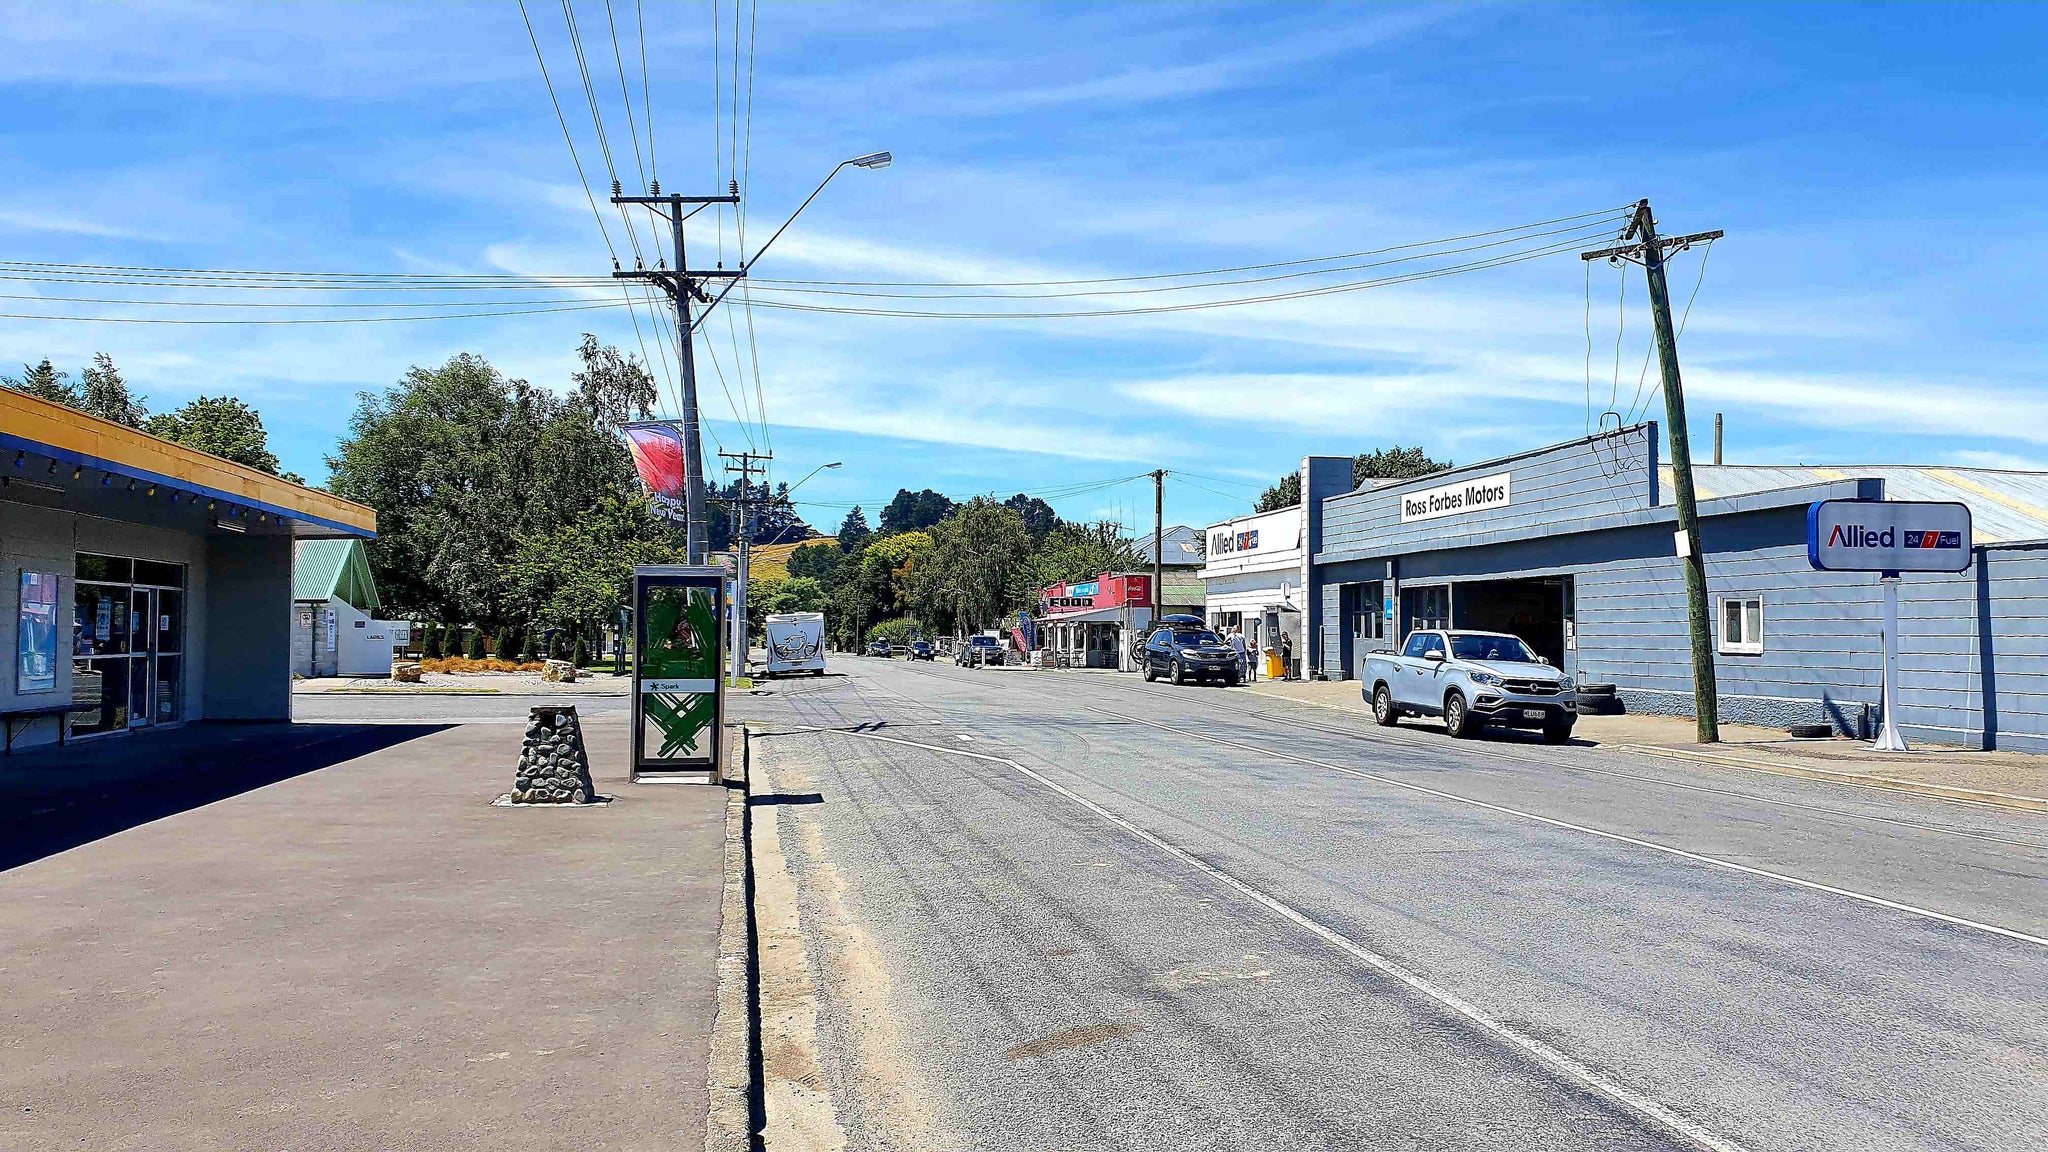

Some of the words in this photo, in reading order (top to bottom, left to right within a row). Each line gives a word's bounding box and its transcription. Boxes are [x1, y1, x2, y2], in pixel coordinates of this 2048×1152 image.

[654, 491, 682, 508] Happy
[1406, 499, 1427, 517] Ross
[1429, 492, 1462, 513] Forbes
[1465, 485, 1504, 506] Motors
[650, 503, 667, 518] New
[1211, 530, 1235, 556] Allied
[1827, 525, 1895, 548] Allied
[1907, 534, 1919, 544] 24
[1940, 535, 1960, 545] Fuel
[1050, 598, 1093, 607] FOOD
